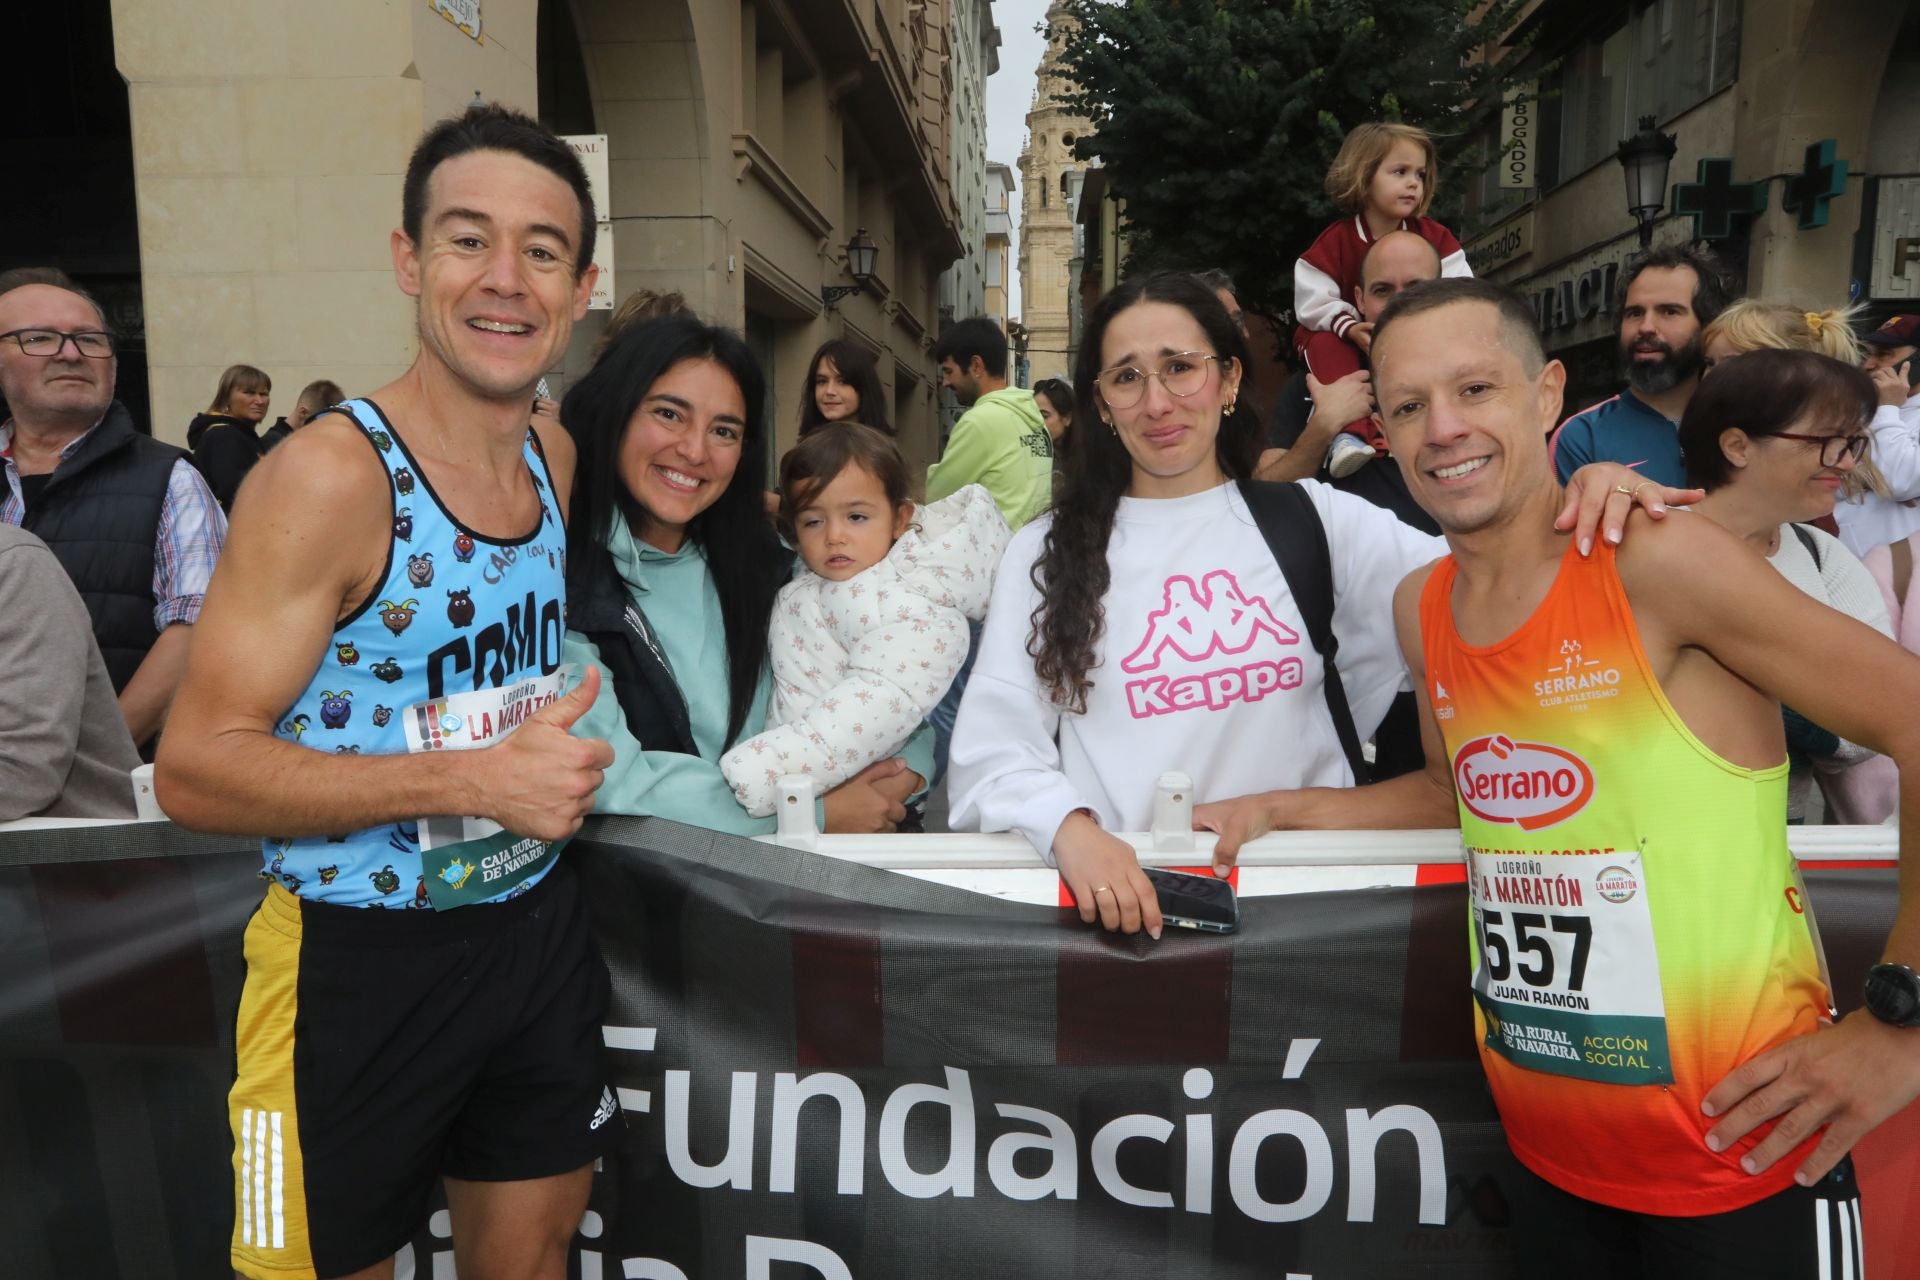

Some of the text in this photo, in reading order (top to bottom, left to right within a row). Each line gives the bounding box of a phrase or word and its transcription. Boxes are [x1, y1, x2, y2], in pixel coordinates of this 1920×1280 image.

[1530, 258, 1626, 336] MACI
[483, 545, 522, 585] CAB
[427, 591, 561, 700] COMO
[1125, 657, 1303, 719] Kappa
[1534, 668, 1621, 697] SERRANO
[1540, 687, 1619, 708] CLUB ATLETISMO
[467, 712, 493, 741] LA
[1463, 762, 1576, 800] Serrano
[481, 838, 543, 869] CAJA RURA
[482, 844, 546, 883] DE NAVARR
[1497, 860, 1542, 875] LOGROÑO
[1495, 873, 1584, 907] MARATÓN
[1483, 908, 1593, 992] 557
[1495, 985, 1590, 1011] JUAN RAMÓN
[1516, 1038, 1581, 1061] NAVARRA
[1525, 1025, 1572, 1046] RURAL
[1584, 1034, 1648, 1052] ACCIÓN
[1585, 1051, 1650, 1069] SOCIAL
[594, 1025, 1448, 1226] Fundación
